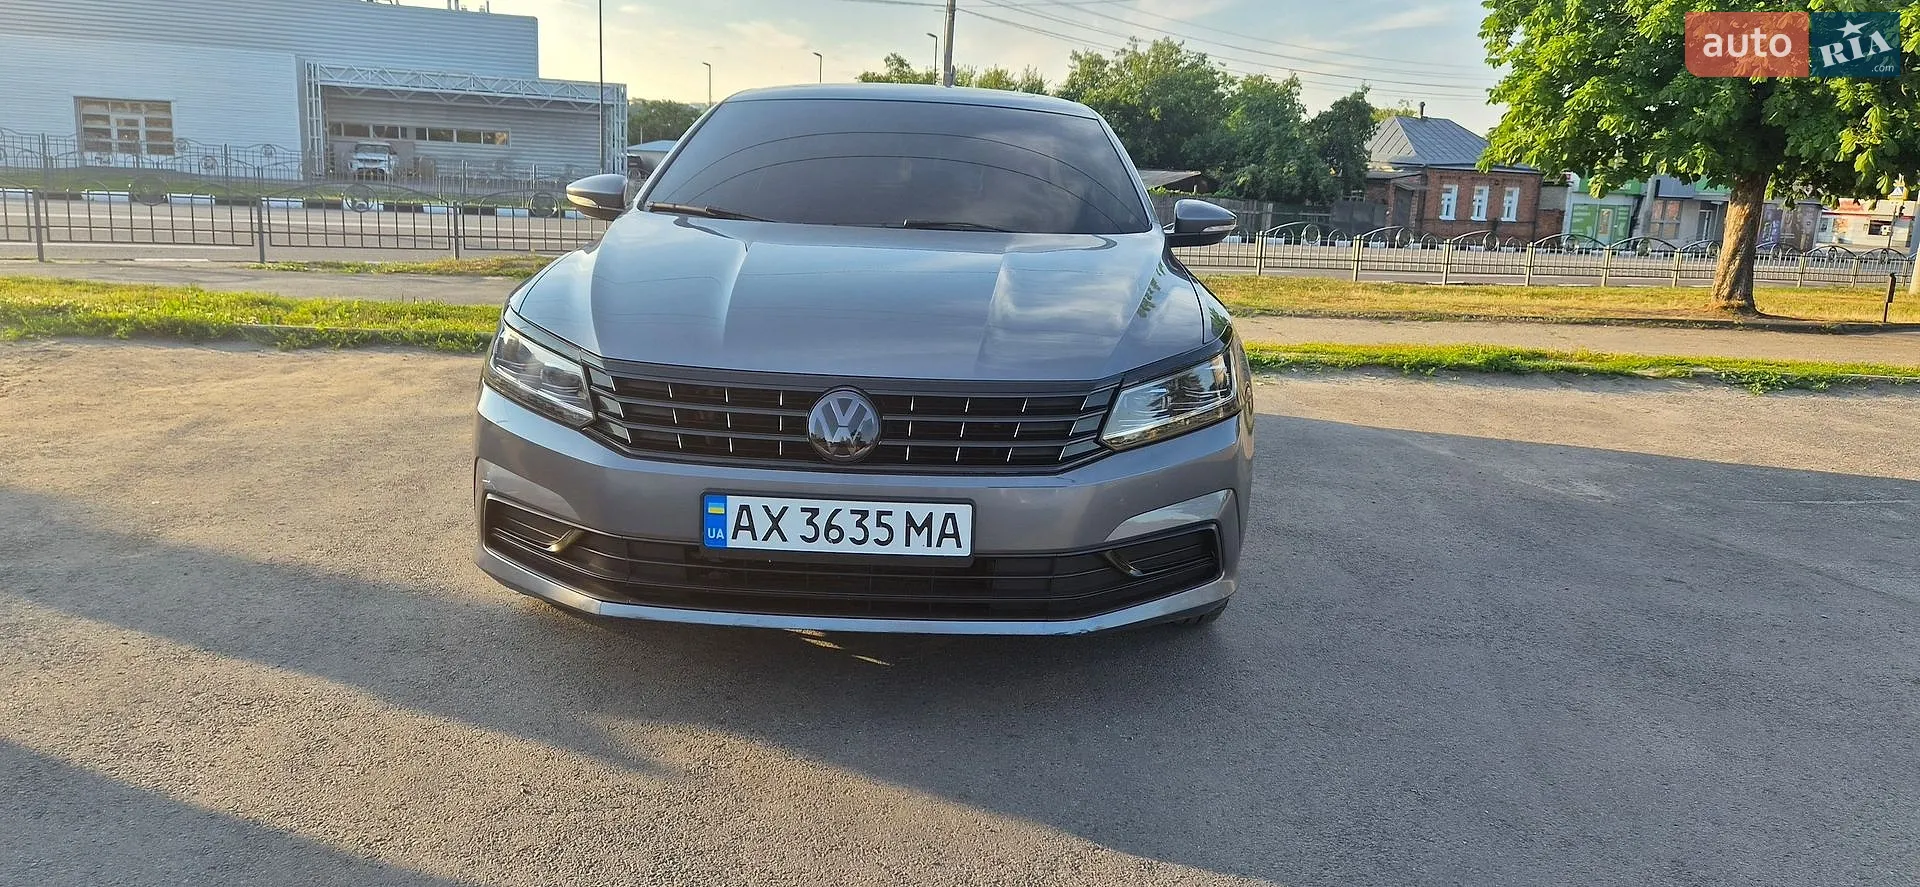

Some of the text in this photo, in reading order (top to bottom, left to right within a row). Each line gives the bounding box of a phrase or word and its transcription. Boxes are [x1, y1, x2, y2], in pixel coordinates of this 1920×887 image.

[707, 528, 725, 539] UA
[731, 504, 962, 549] AX 3635 MA
